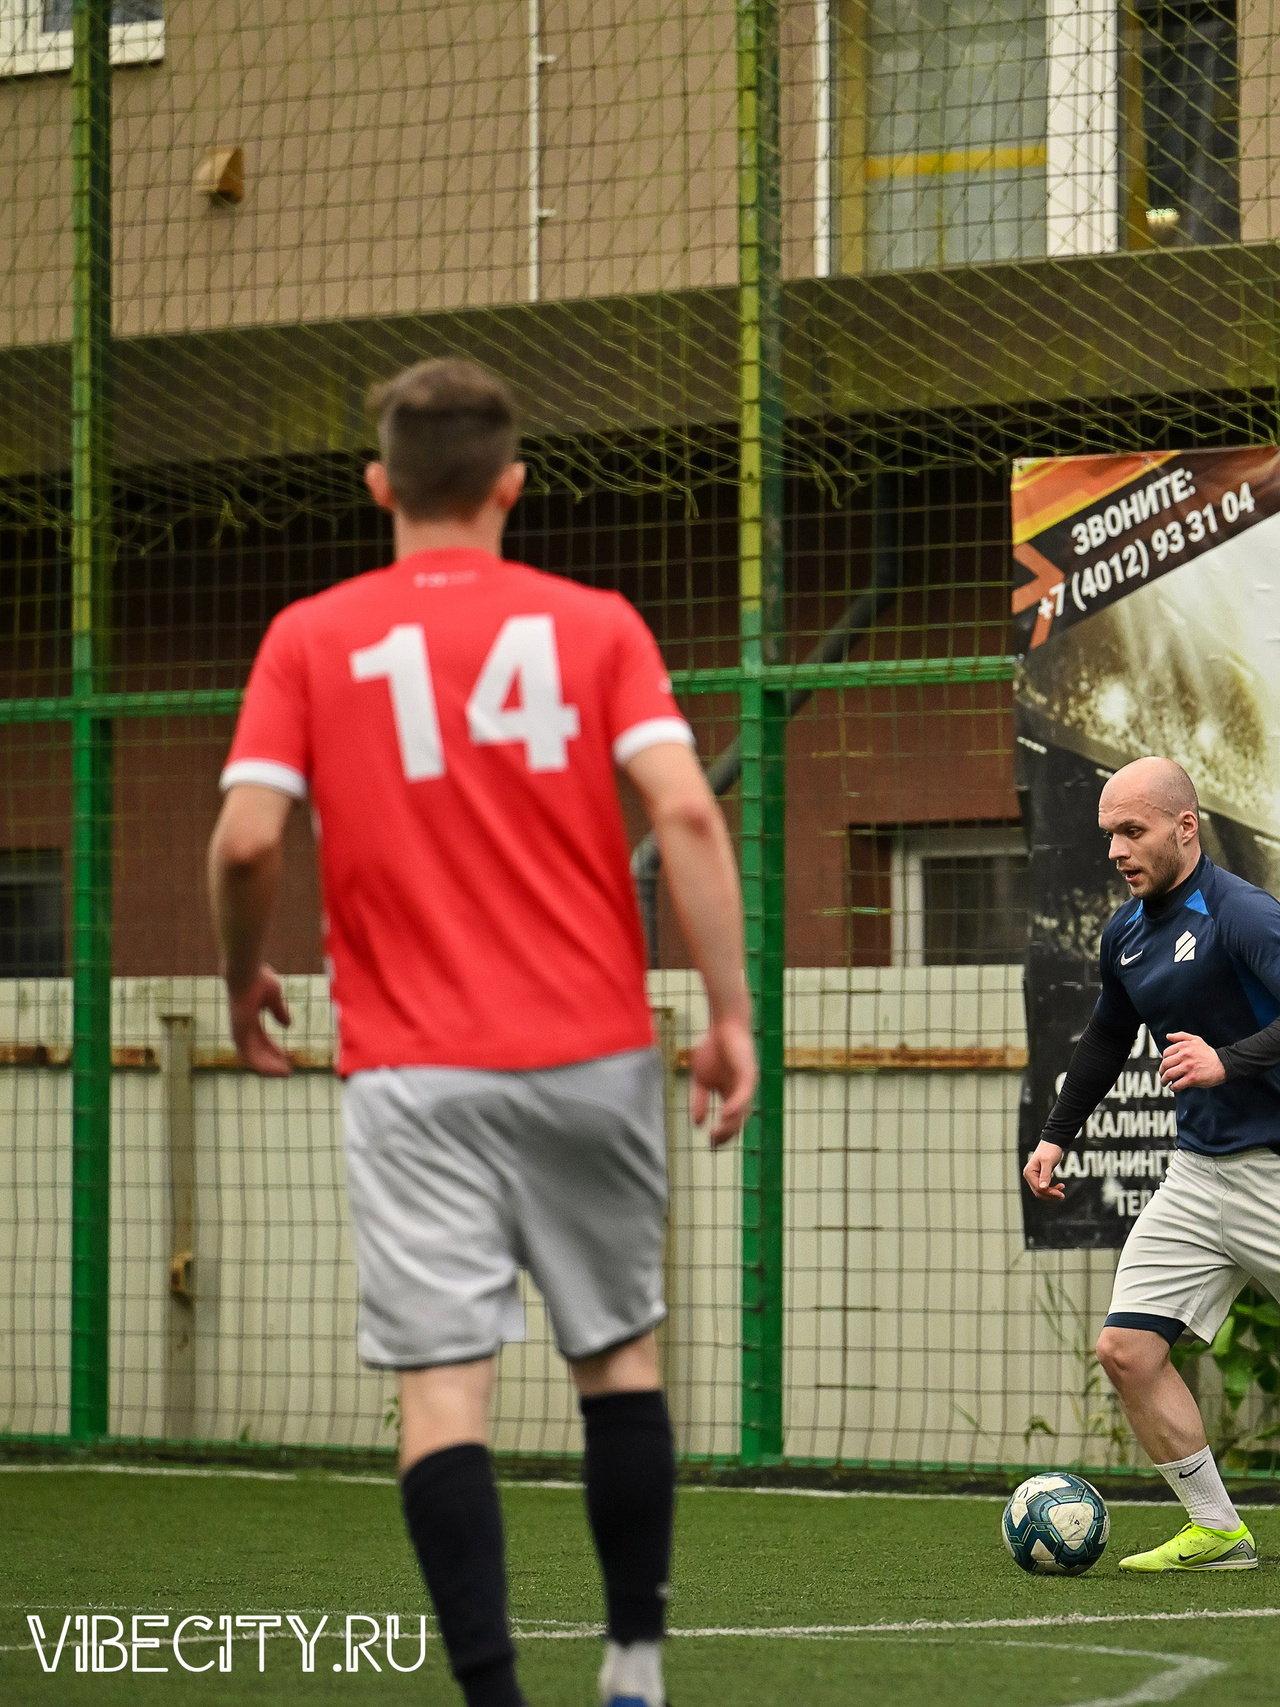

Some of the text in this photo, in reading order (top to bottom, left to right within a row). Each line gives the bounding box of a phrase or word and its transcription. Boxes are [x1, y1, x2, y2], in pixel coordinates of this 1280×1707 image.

[1037, 481, 1256, 620] +7 (4012) 93 31 04
[1071, 467, 1196, 556] ЗВОНИТЕ:
[348, 612, 582, 784] 14
